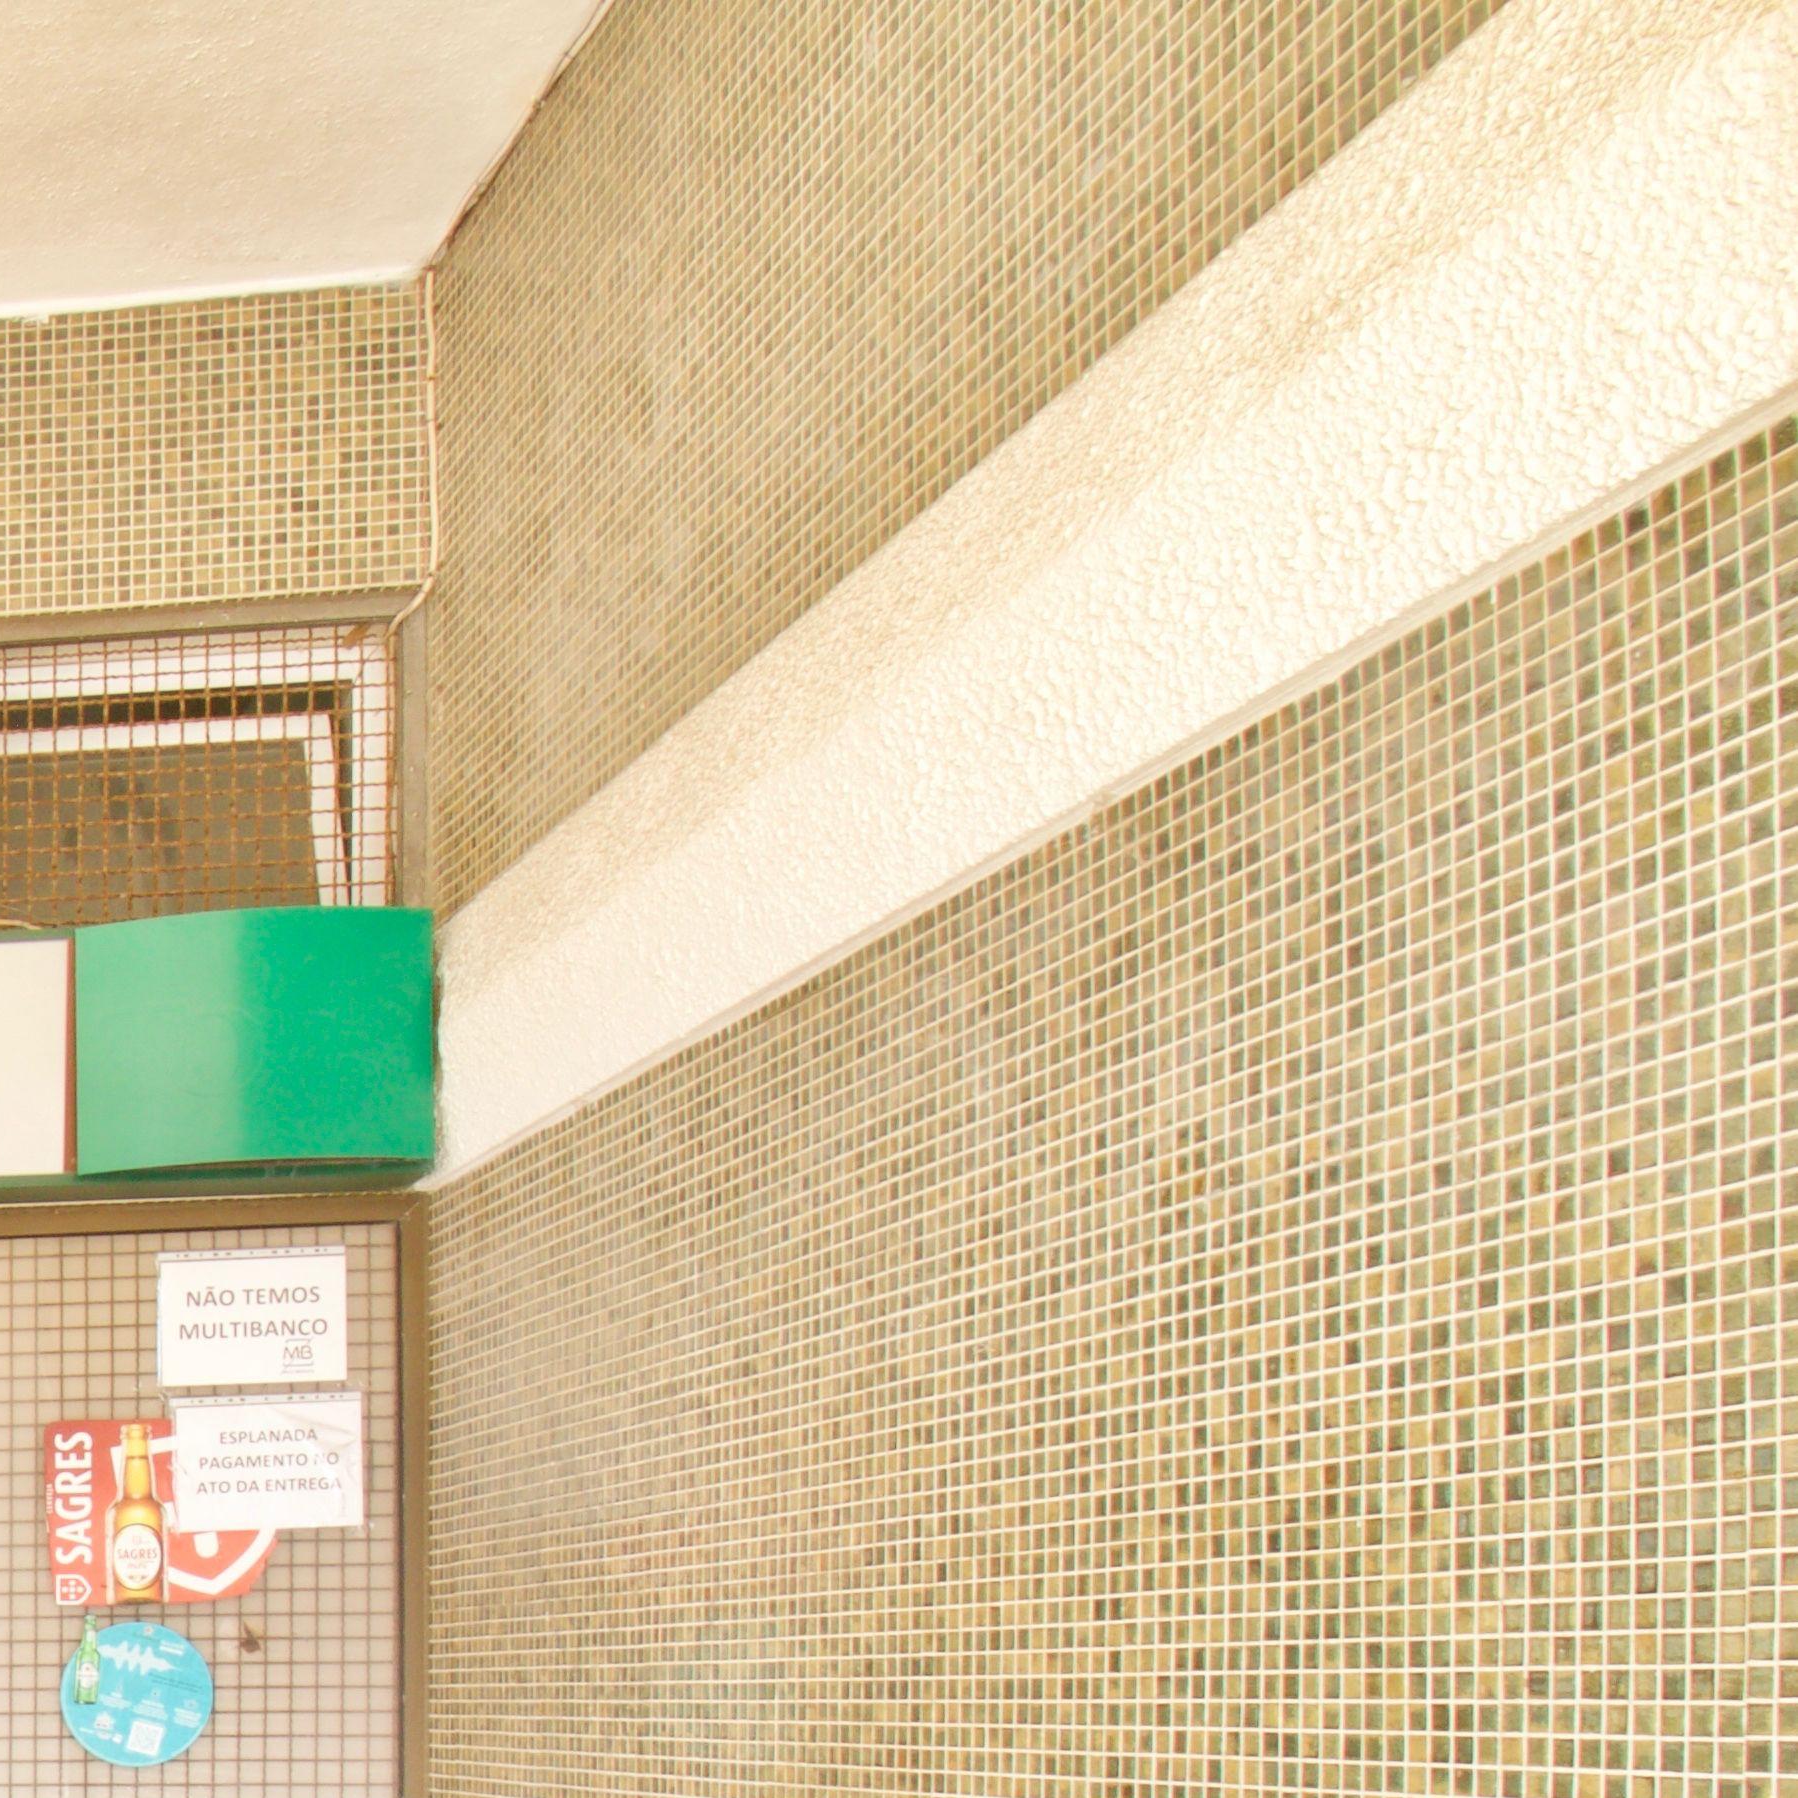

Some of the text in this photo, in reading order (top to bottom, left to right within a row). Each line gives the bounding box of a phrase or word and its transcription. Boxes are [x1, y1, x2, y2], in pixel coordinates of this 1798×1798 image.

[186, 1286, 321, 1308] NÃO TEMOS
[179, 1318, 329, 1341] MULTIBANCO
[220, 1428, 318, 1445] ESPLANADA
[199, 1453, 308, 1469] PAGAMENTO
[197, 1477, 342, 1495] ATO DA ENTREGA
[54, 1431, 94, 1565] SAGRES
[117, 1547, 158, 1560] SAGRES
